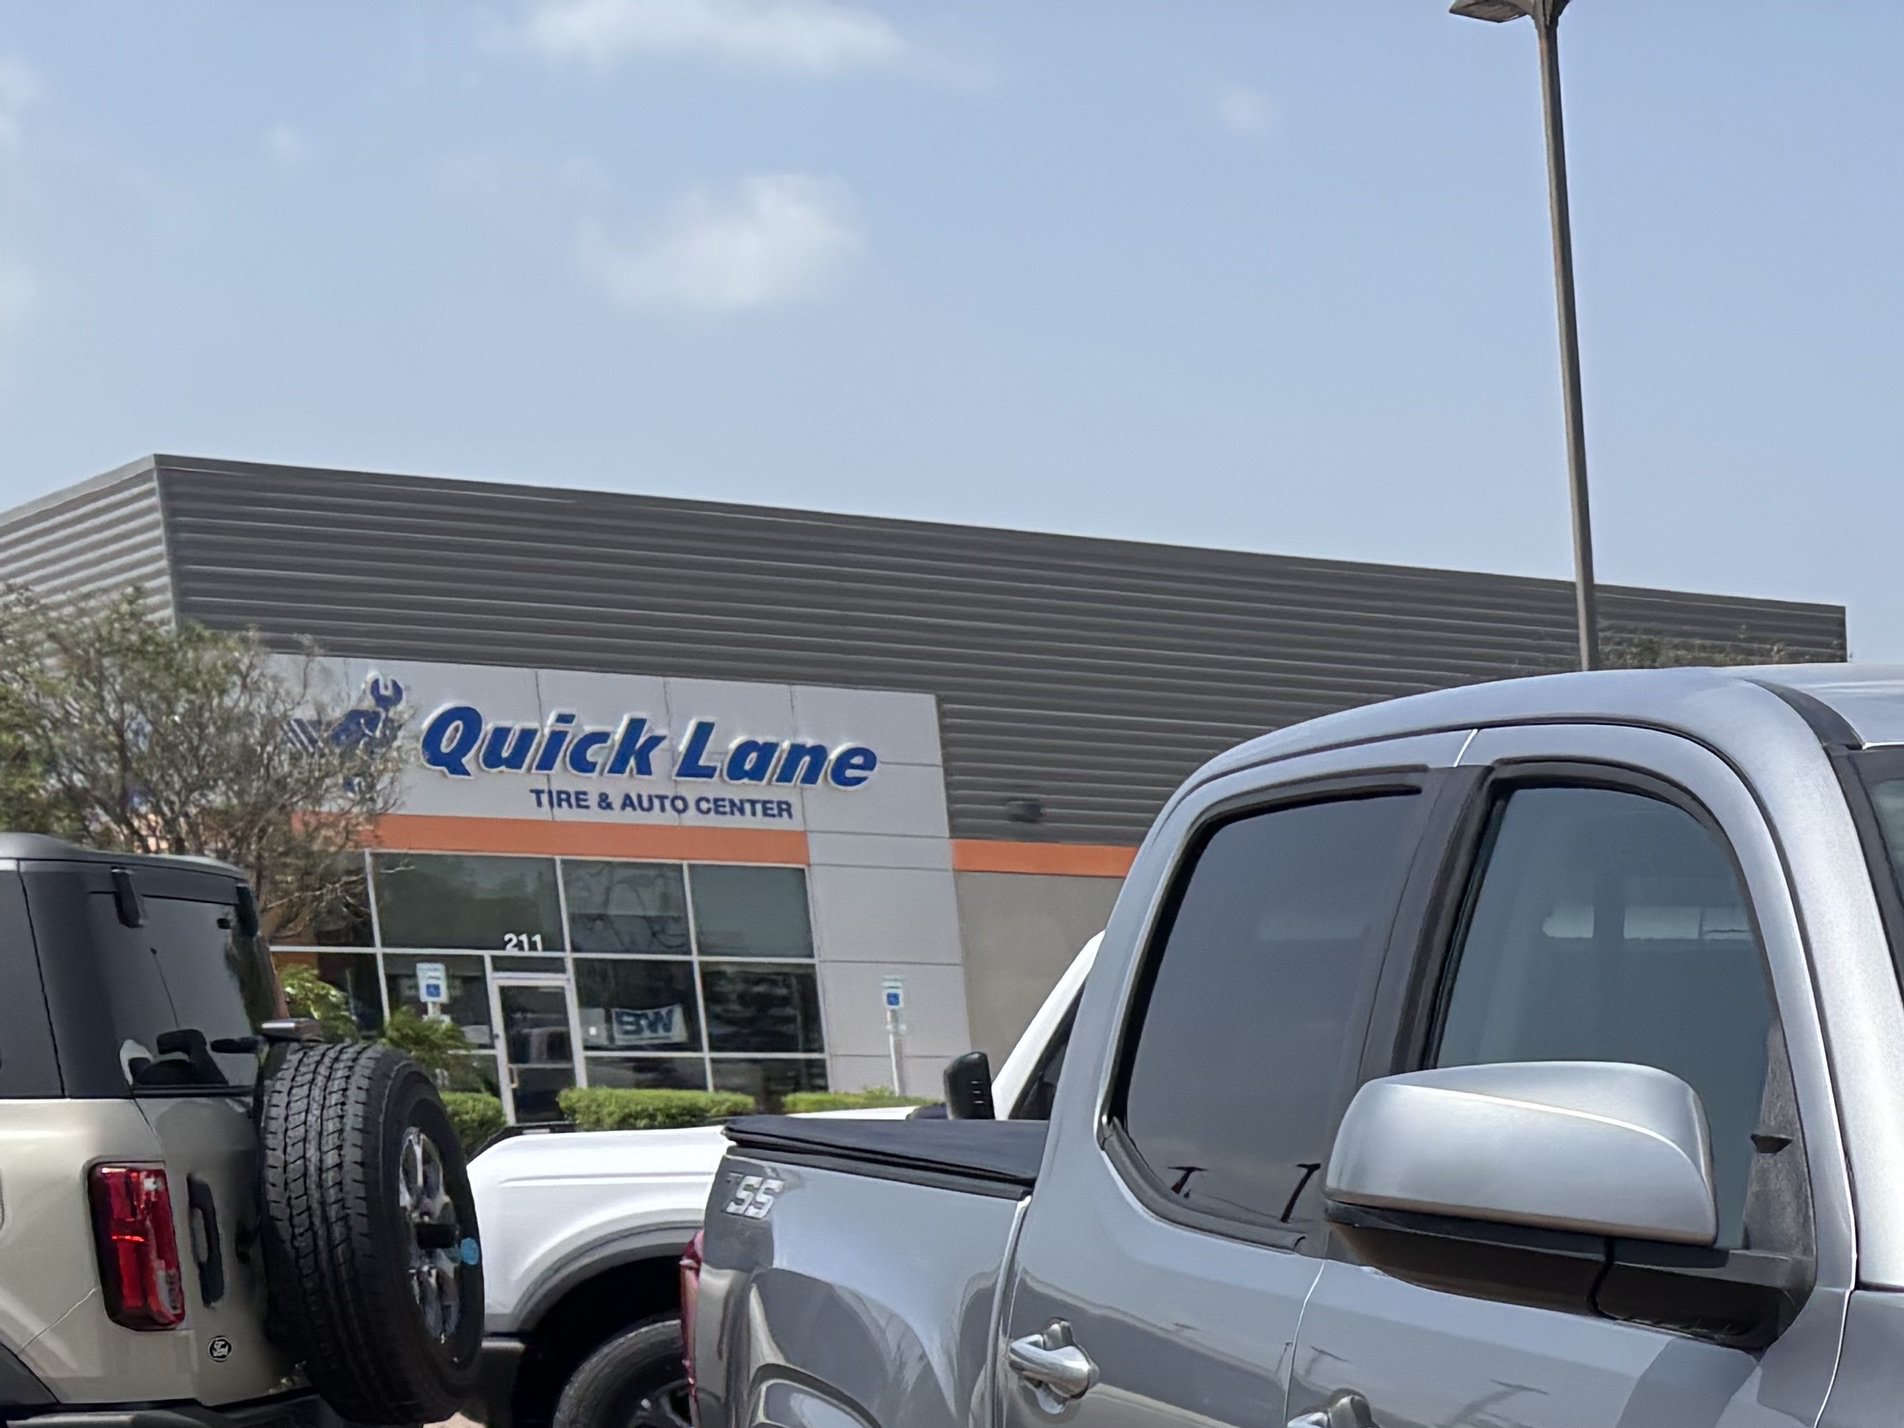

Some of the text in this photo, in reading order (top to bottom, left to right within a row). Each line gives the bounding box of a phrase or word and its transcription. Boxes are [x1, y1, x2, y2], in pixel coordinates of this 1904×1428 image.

[421, 705, 878, 788] Quick Lane
[530, 788, 793, 820] TIRE & AUTO CENTER
[503, 932, 543, 952] 211
